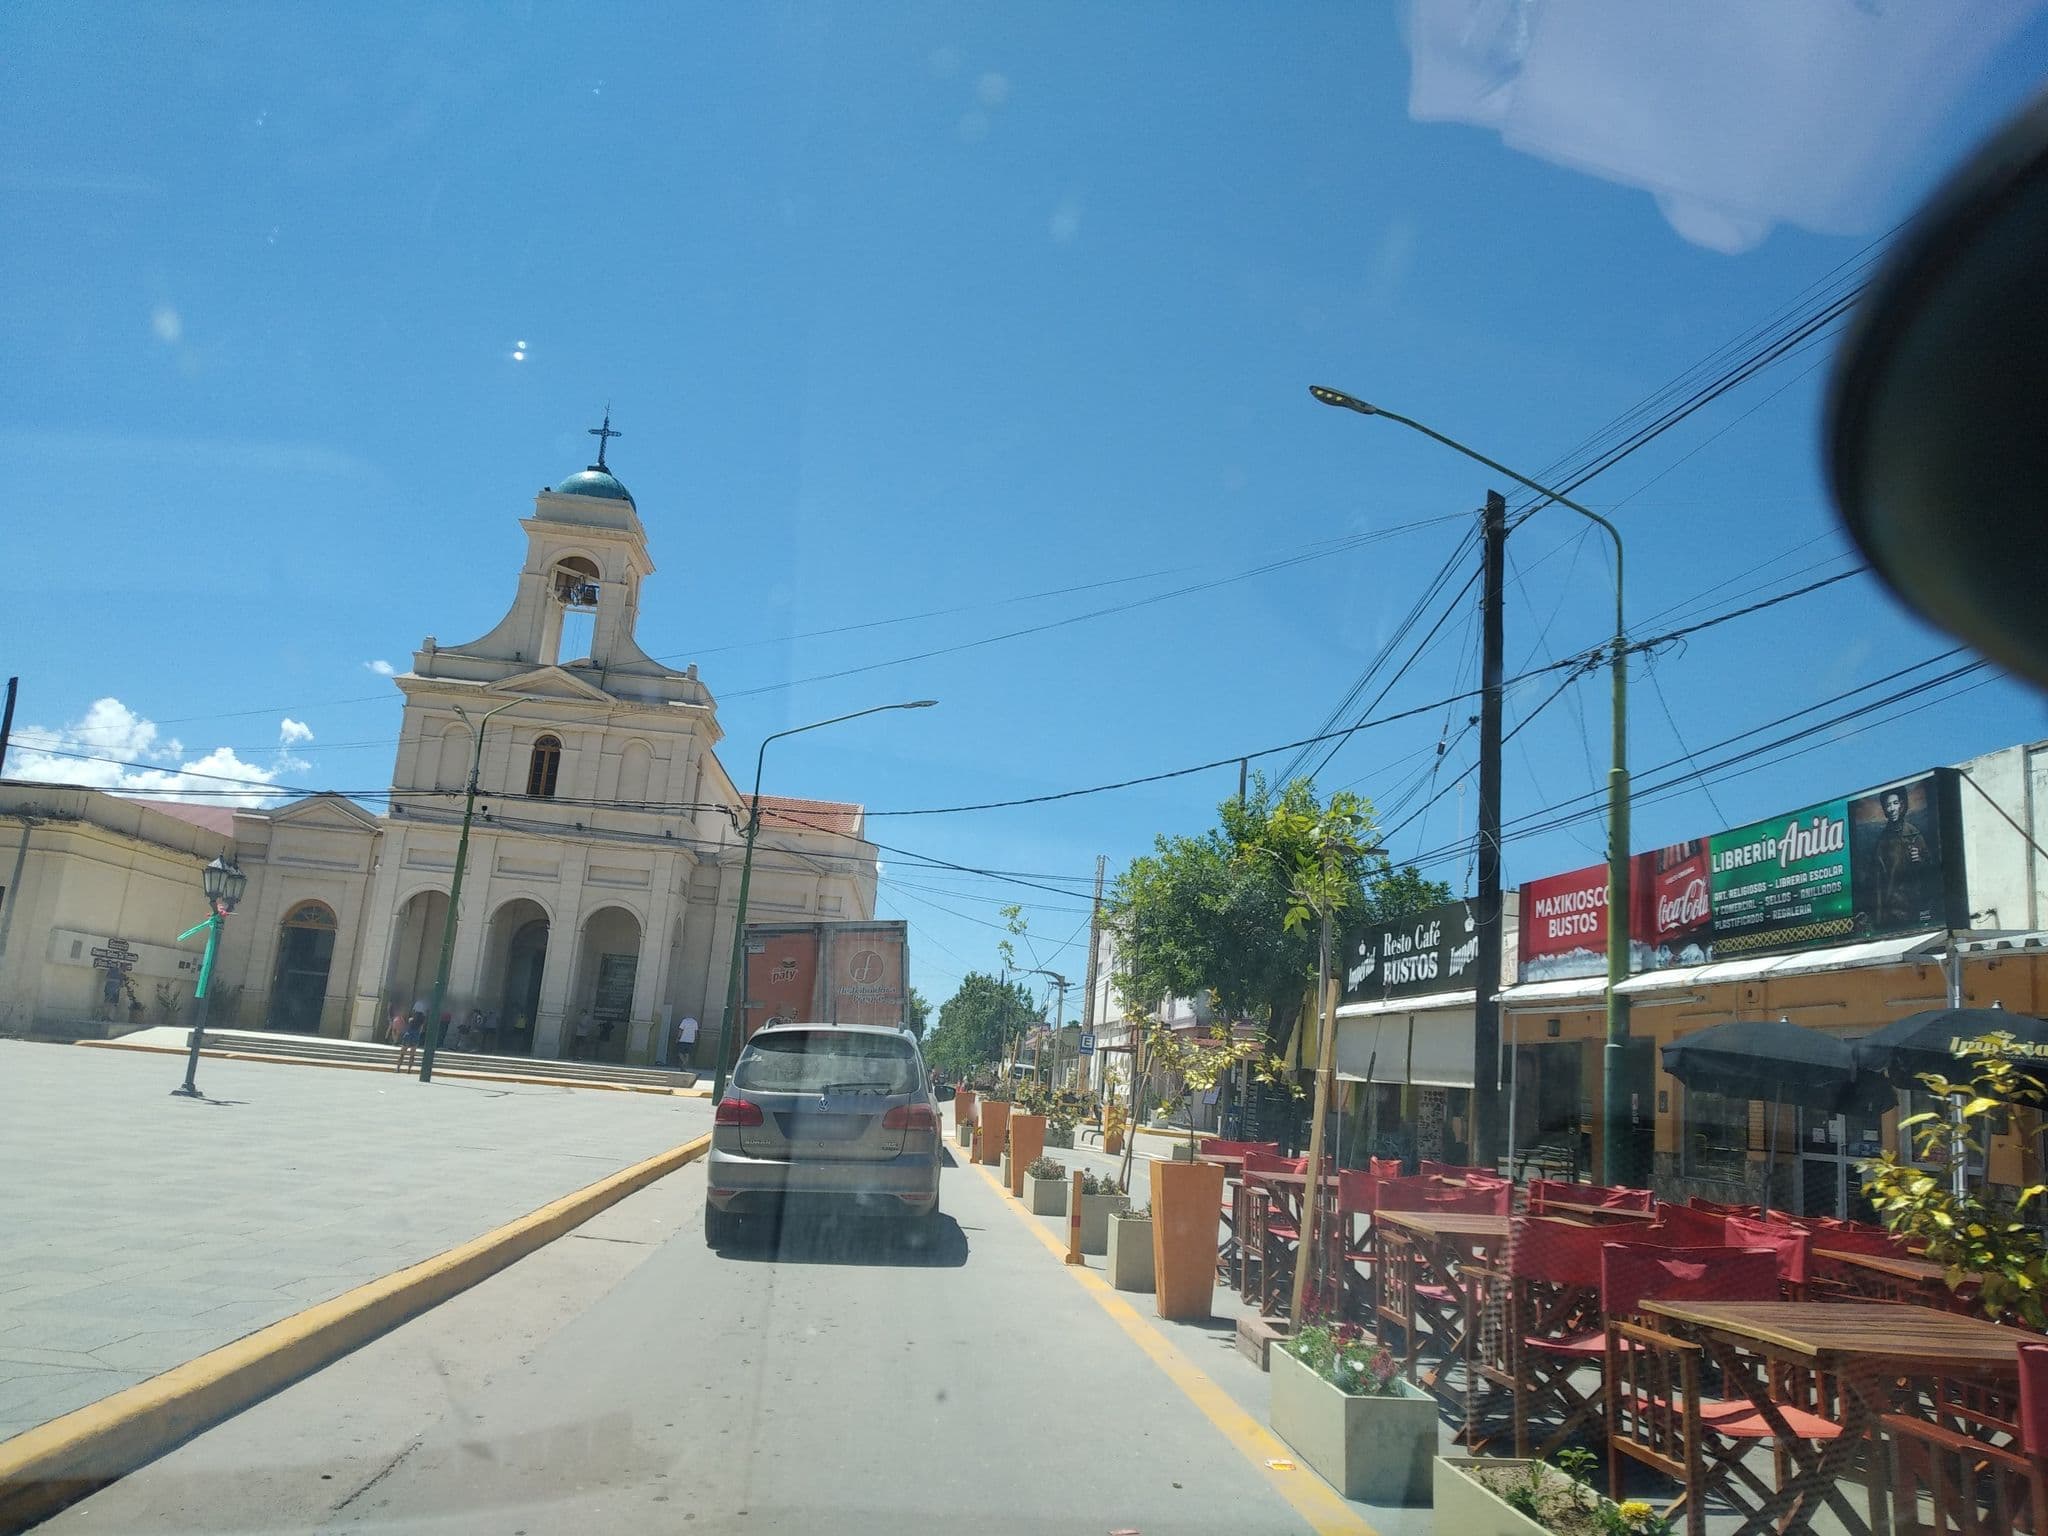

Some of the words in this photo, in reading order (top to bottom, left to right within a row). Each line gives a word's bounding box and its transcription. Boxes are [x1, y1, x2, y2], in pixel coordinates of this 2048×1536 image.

[1712, 834, 1776, 873] LIBRERÍA
[1777, 817, 1843, 868] Anita
[1729, 882, 1767, 898] RELIGIOSOS
[1810, 864, 1843, 881] ESCOLAR
[1765, 892, 1791, 906] SELLOS
[1801, 881, 1842, 899] ANILLADOS
[1657, 878, 1709, 932] Coca-Cola
[1383, 933, 1412, 957] Resto
[1415, 921, 1440, 950] Café
[1548, 912, 1598, 938] BUSTOS
[771, 968, 799, 984] paty
[1383, 952, 1439, 986] BUSTOS
